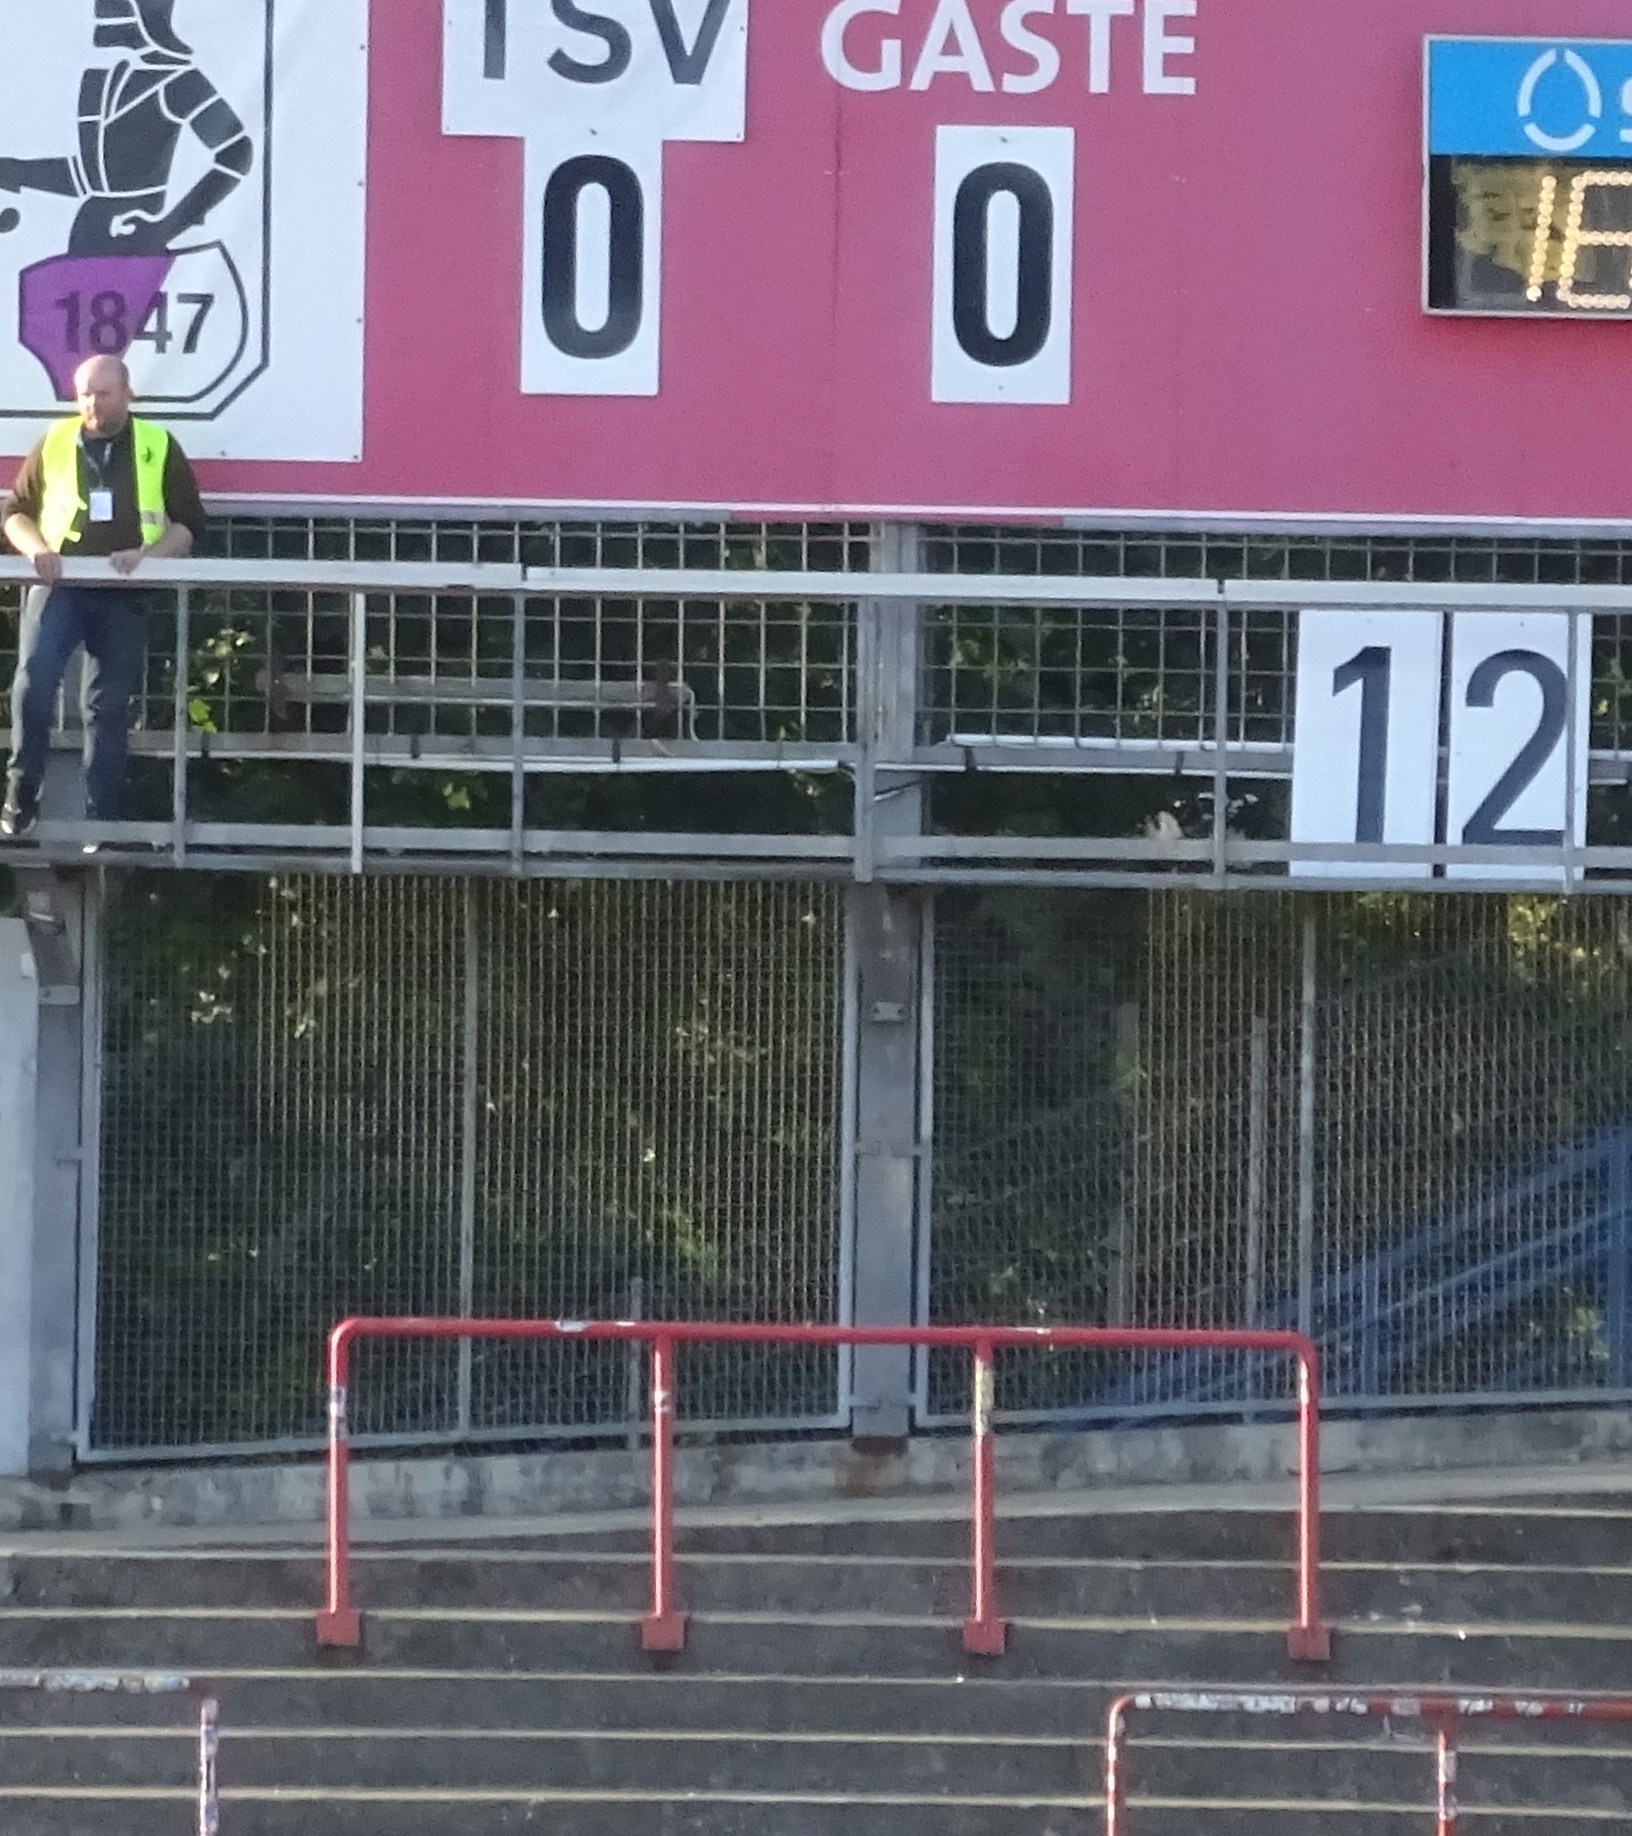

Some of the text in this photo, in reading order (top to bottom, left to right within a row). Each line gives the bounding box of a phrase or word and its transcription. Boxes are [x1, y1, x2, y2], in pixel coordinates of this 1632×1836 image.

[54, 289, 216, 355] 1847
[541, 153, 645, 359] 0
[952, 161, 1055, 367] 0
